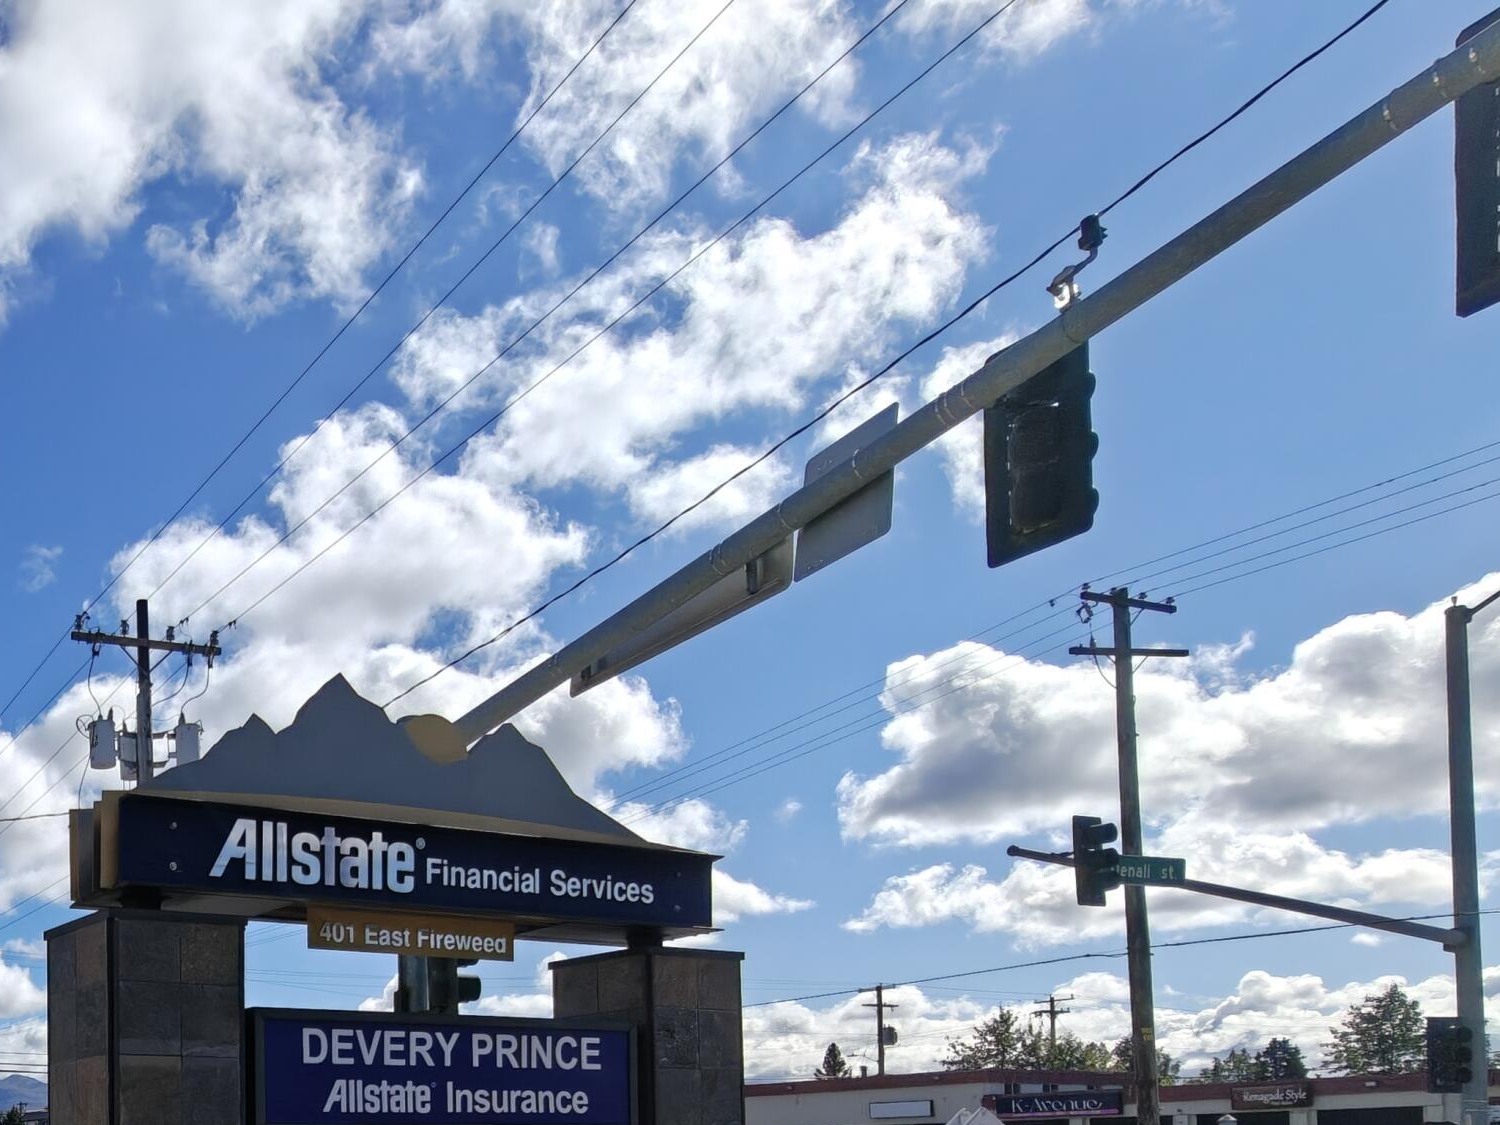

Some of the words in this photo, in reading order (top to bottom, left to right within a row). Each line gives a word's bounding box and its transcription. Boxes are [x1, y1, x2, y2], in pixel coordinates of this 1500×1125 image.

[426, 857, 540, 894] Financial
[550, 869, 654, 904] Services
[1116, 864, 1151, 879] enali
[320, 921, 355, 944] 401
[365, 926, 411, 948] East
[417, 928, 506, 953] Fireweed
[302, 1027, 460, 1067] DEVERY
[472, 1033, 602, 1070] PRINCE
[447, 1081, 589, 1114] Insurance
